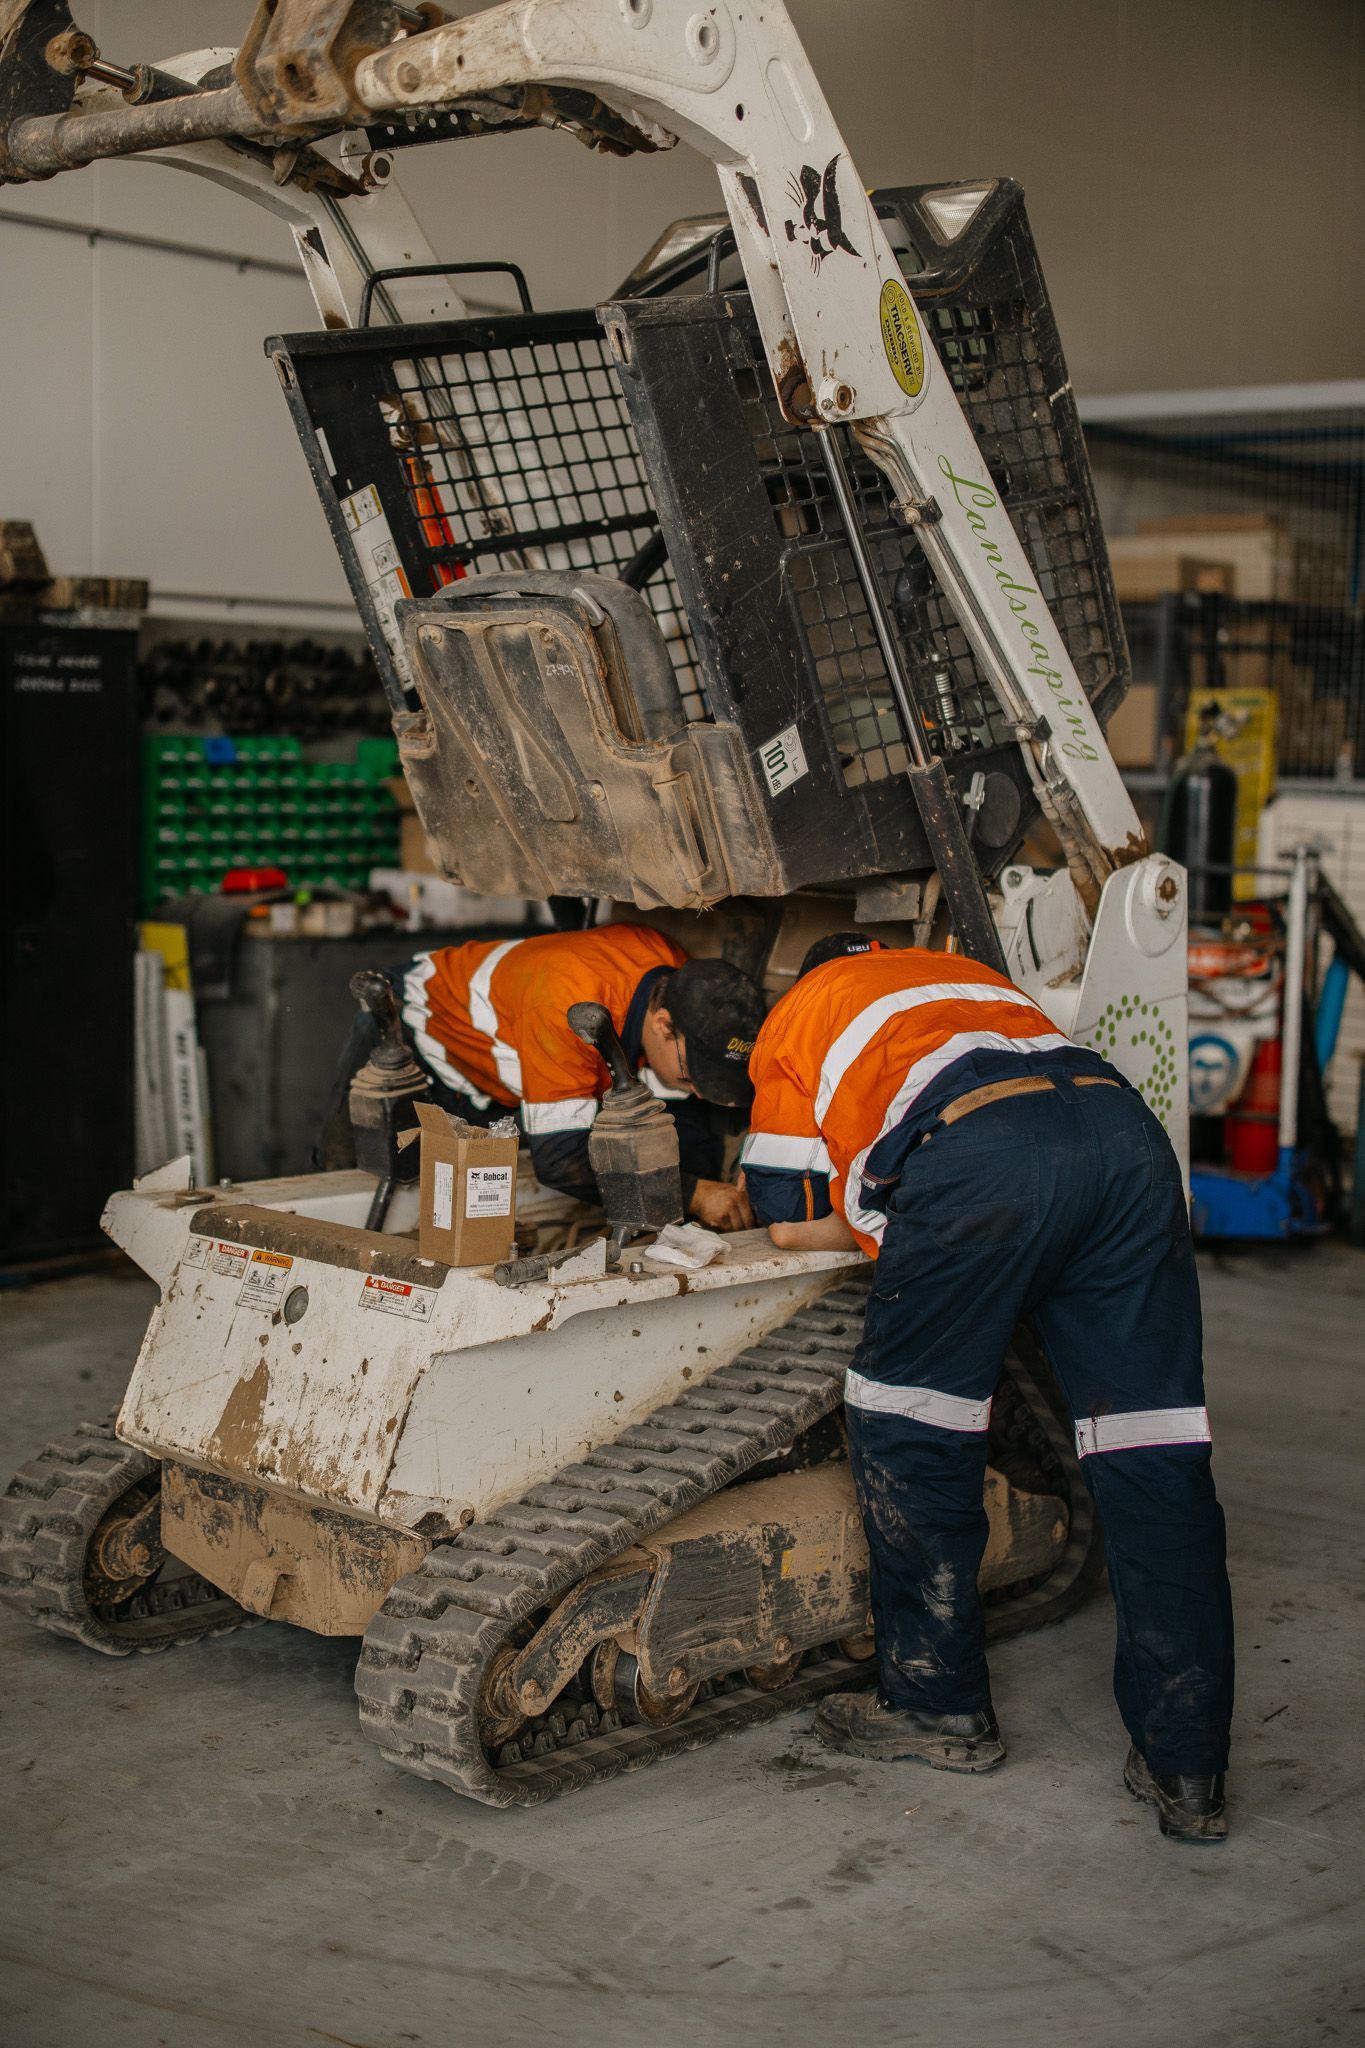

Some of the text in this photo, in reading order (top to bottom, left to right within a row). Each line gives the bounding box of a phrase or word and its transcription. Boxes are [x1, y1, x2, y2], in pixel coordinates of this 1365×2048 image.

[885, 318, 899, 365] DUBBO
[890, 304, 914, 376] TRACSERV
[898, 292, 907, 313] SOLD
[905, 325, 919, 364] SERVICED
[915, 366, 922, 376] BY
[937, 454, 1099, 762] Landscaping
[764, 740, 789, 791] 101 dB
[483, 1172, 508, 1182] Bobcat
[221, 1245, 246, 1257] DANGER
[264, 1254, 289, 1266] WARNING
[380, 1281, 405, 1293] DANGER
